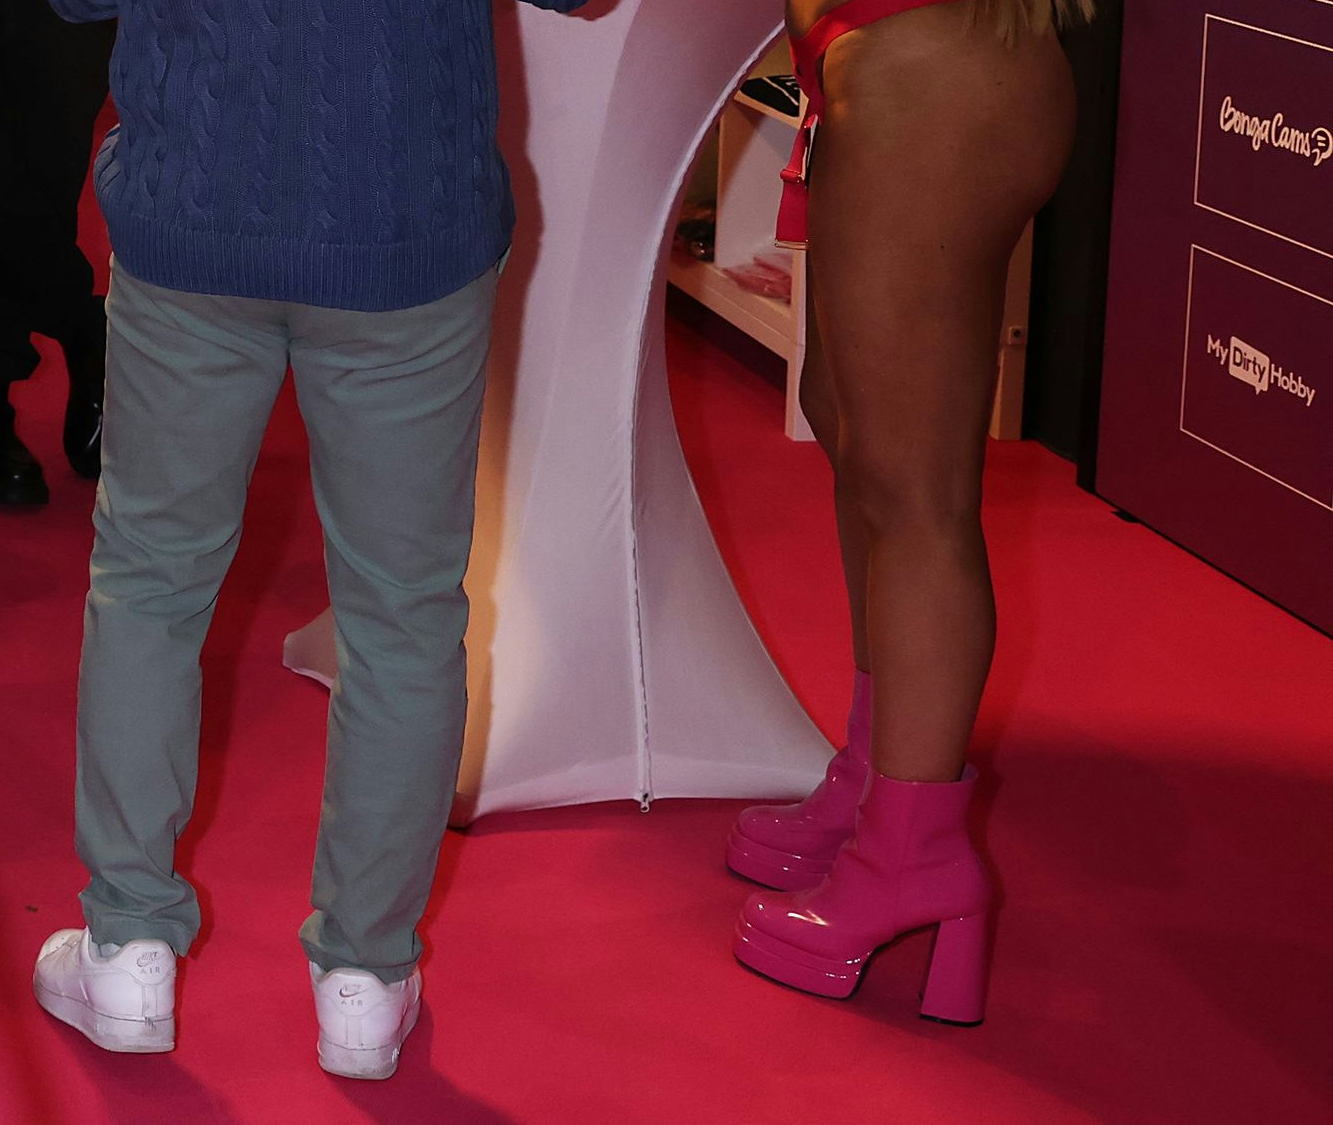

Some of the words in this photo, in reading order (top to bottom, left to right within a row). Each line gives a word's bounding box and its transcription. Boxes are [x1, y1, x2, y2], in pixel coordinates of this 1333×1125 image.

[1206, 334, 1228, 365] My
[1232, 346, 1266, 383] Dirty
[1270, 363, 1316, 407] Hobby
